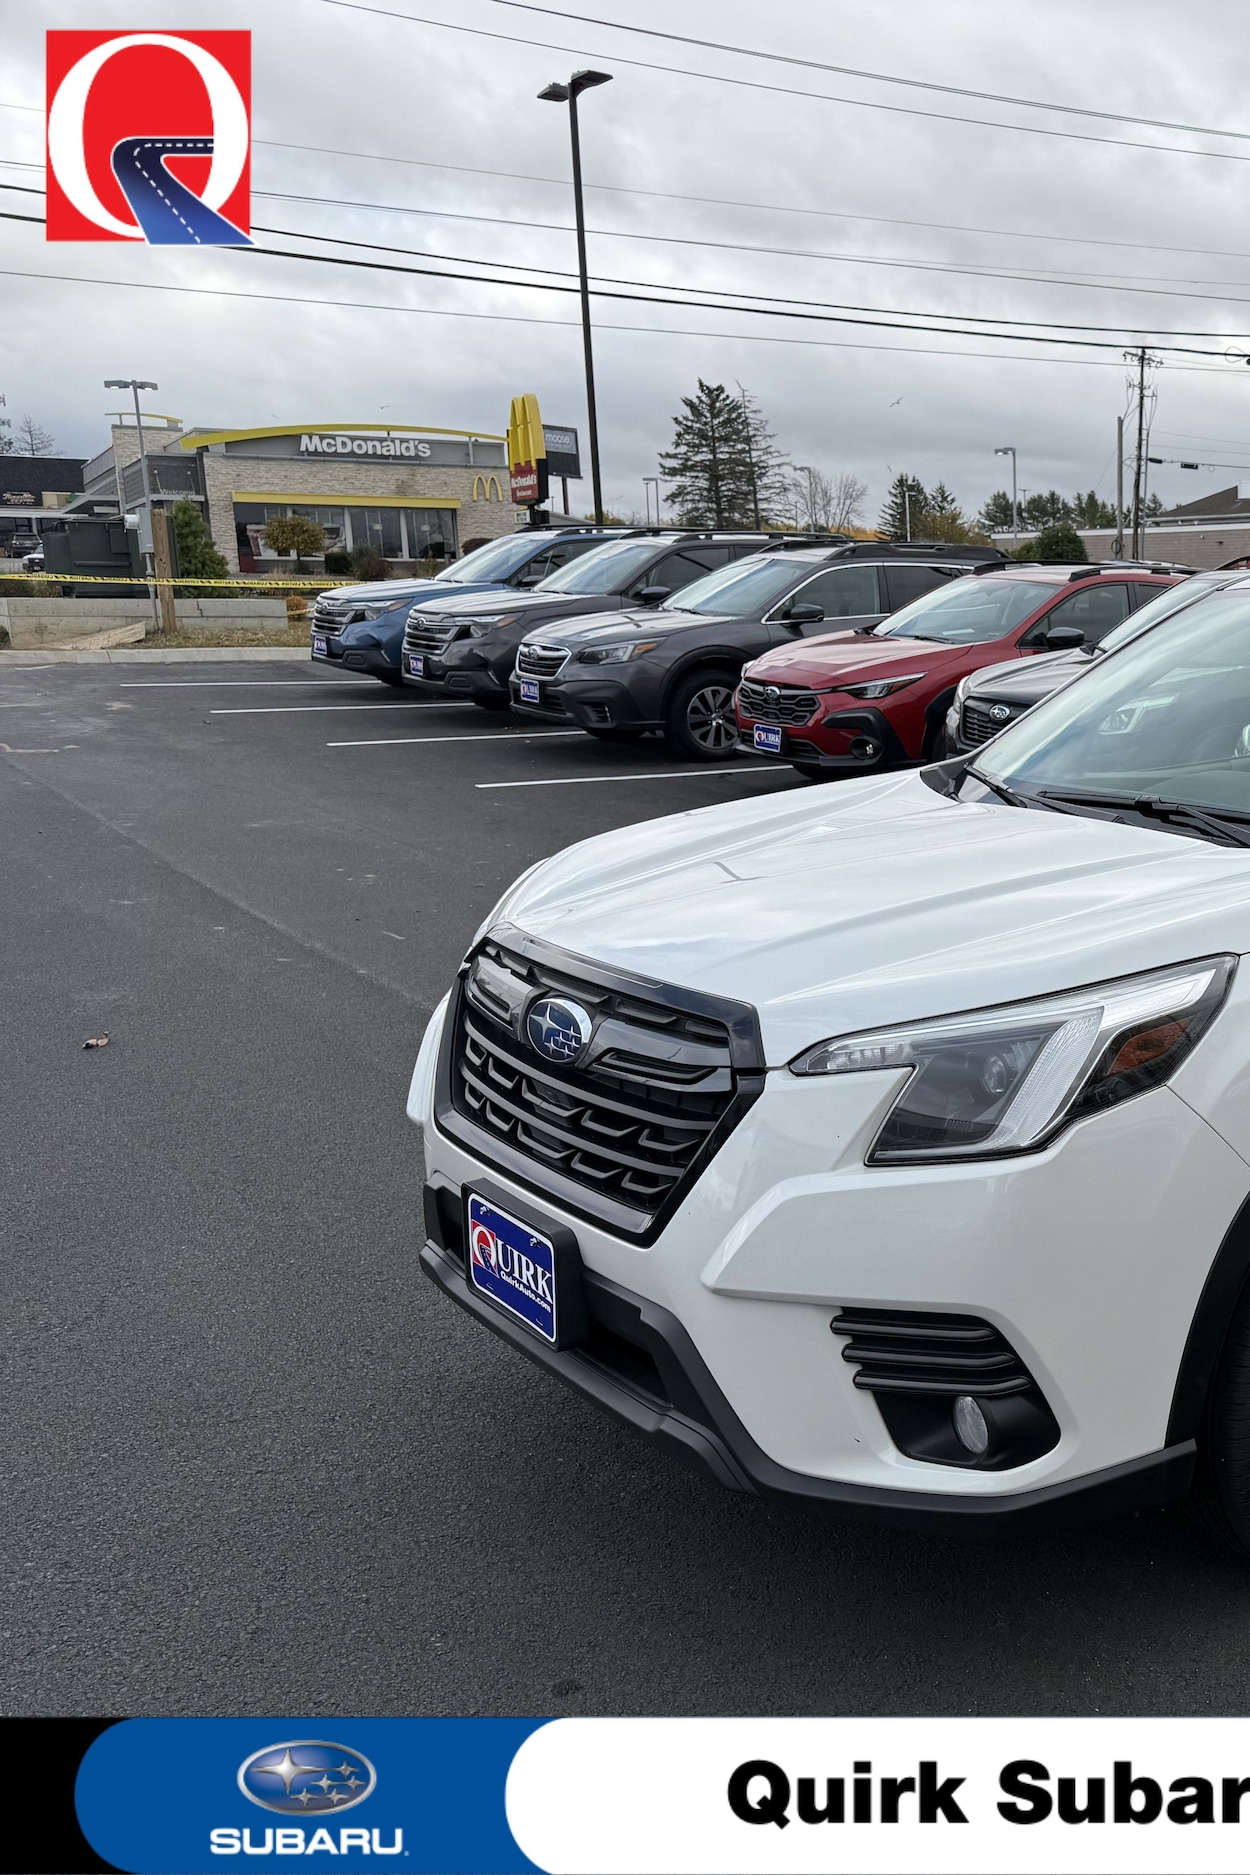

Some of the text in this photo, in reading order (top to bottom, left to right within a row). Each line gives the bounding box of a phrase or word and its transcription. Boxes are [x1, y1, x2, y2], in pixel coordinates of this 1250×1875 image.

[300, 434, 431, 457] McDonald's
[160, 488, 195, 496] Welcome
[755, 730, 780, 744] QUIRK
[472, 1225, 553, 1305] QUIRK
[500, 1270, 552, 1314] QuirkAuto.com
